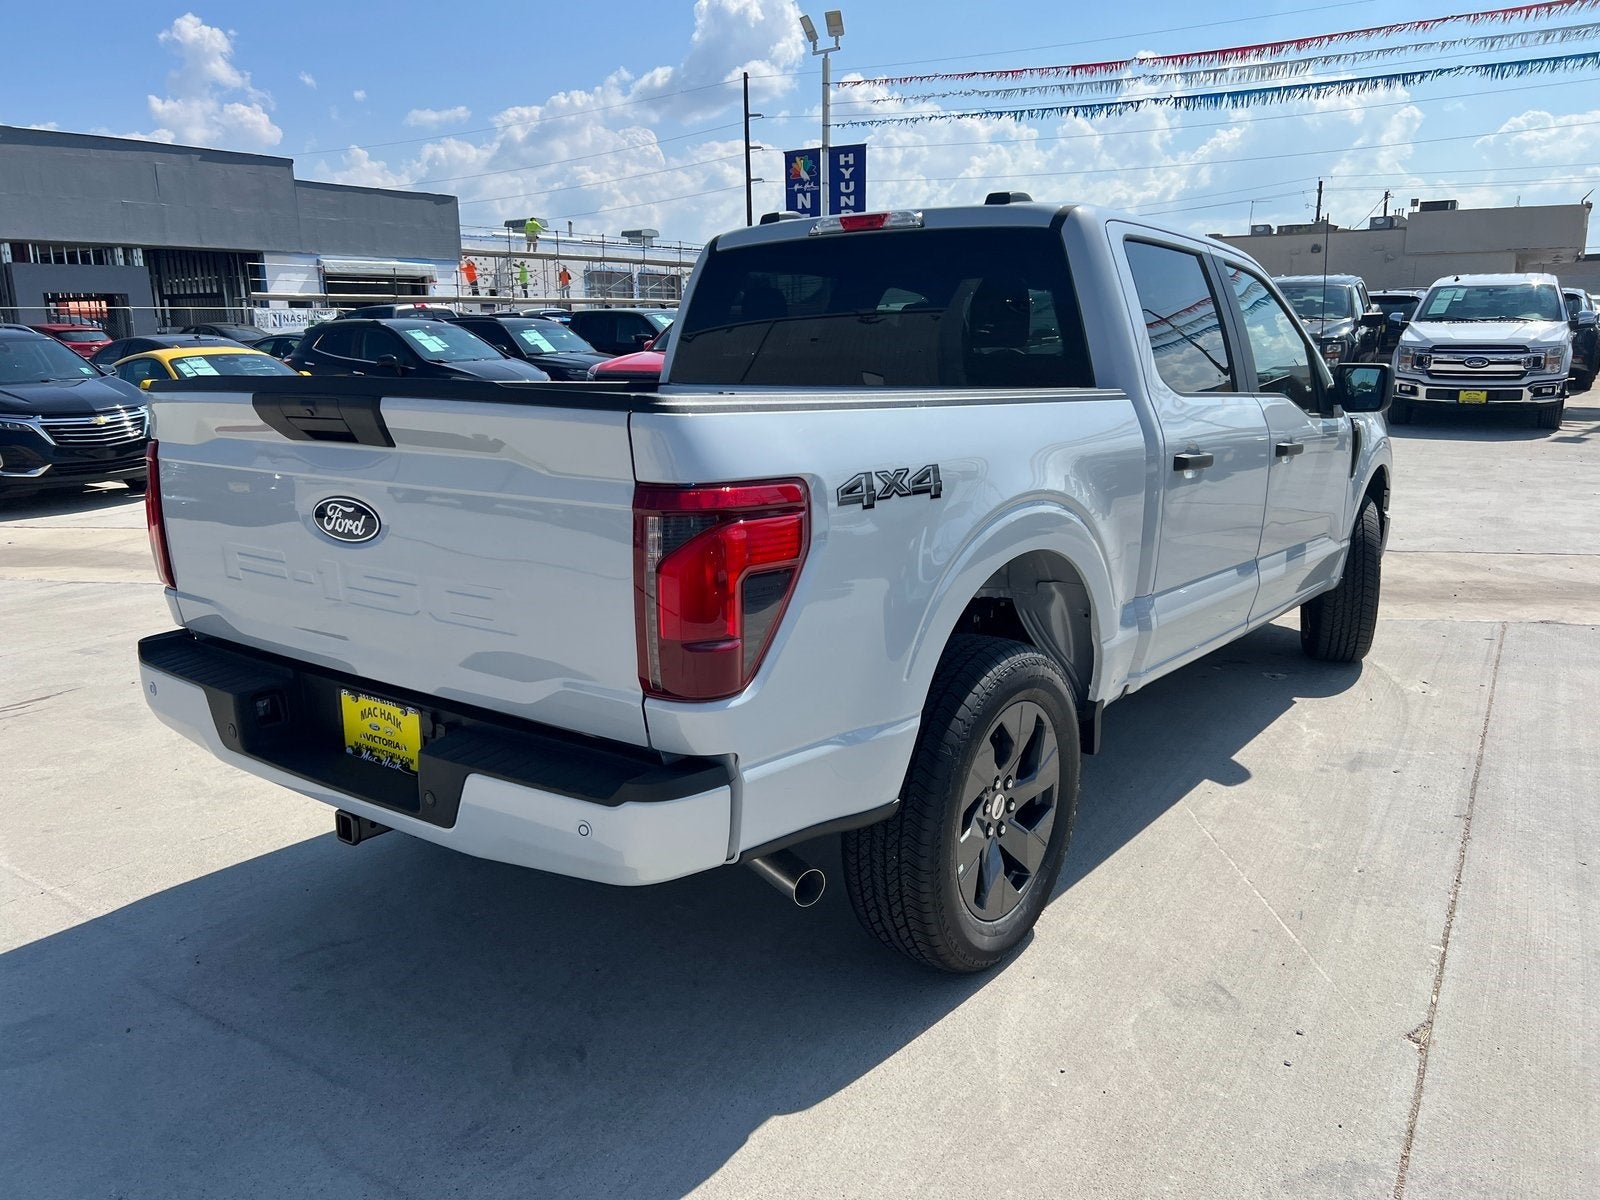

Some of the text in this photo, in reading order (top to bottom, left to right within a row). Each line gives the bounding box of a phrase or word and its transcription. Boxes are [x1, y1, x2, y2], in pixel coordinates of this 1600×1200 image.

[283, 314, 308, 323] NASH
[323, 502, 366, 536] Ford
[361, 706, 378, 721] MAC
[380, 707, 403, 732] HAIK
[366, 733, 400, 751] VICTORIA
[361, 749, 378, 764] Mac
